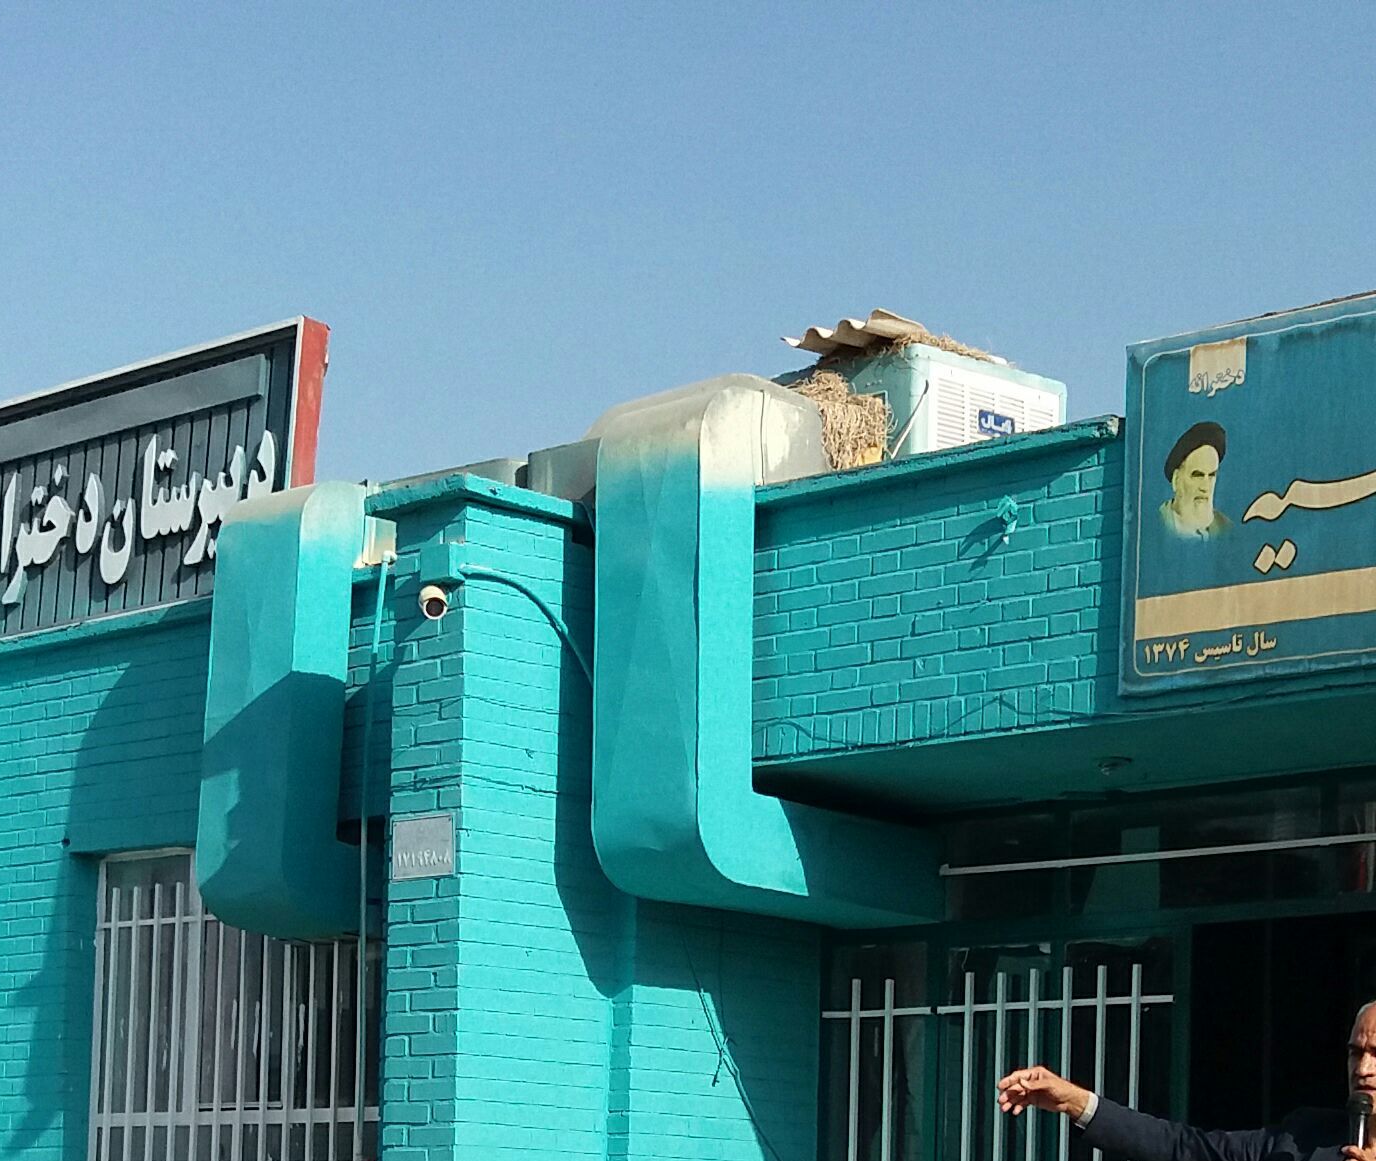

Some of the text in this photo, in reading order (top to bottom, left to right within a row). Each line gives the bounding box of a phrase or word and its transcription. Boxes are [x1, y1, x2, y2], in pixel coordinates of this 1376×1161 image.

[1188, 367, 1245, 398] دخترانه
[1144, 630, 1278, 665] سال تاسیس ۱۳۷۴
